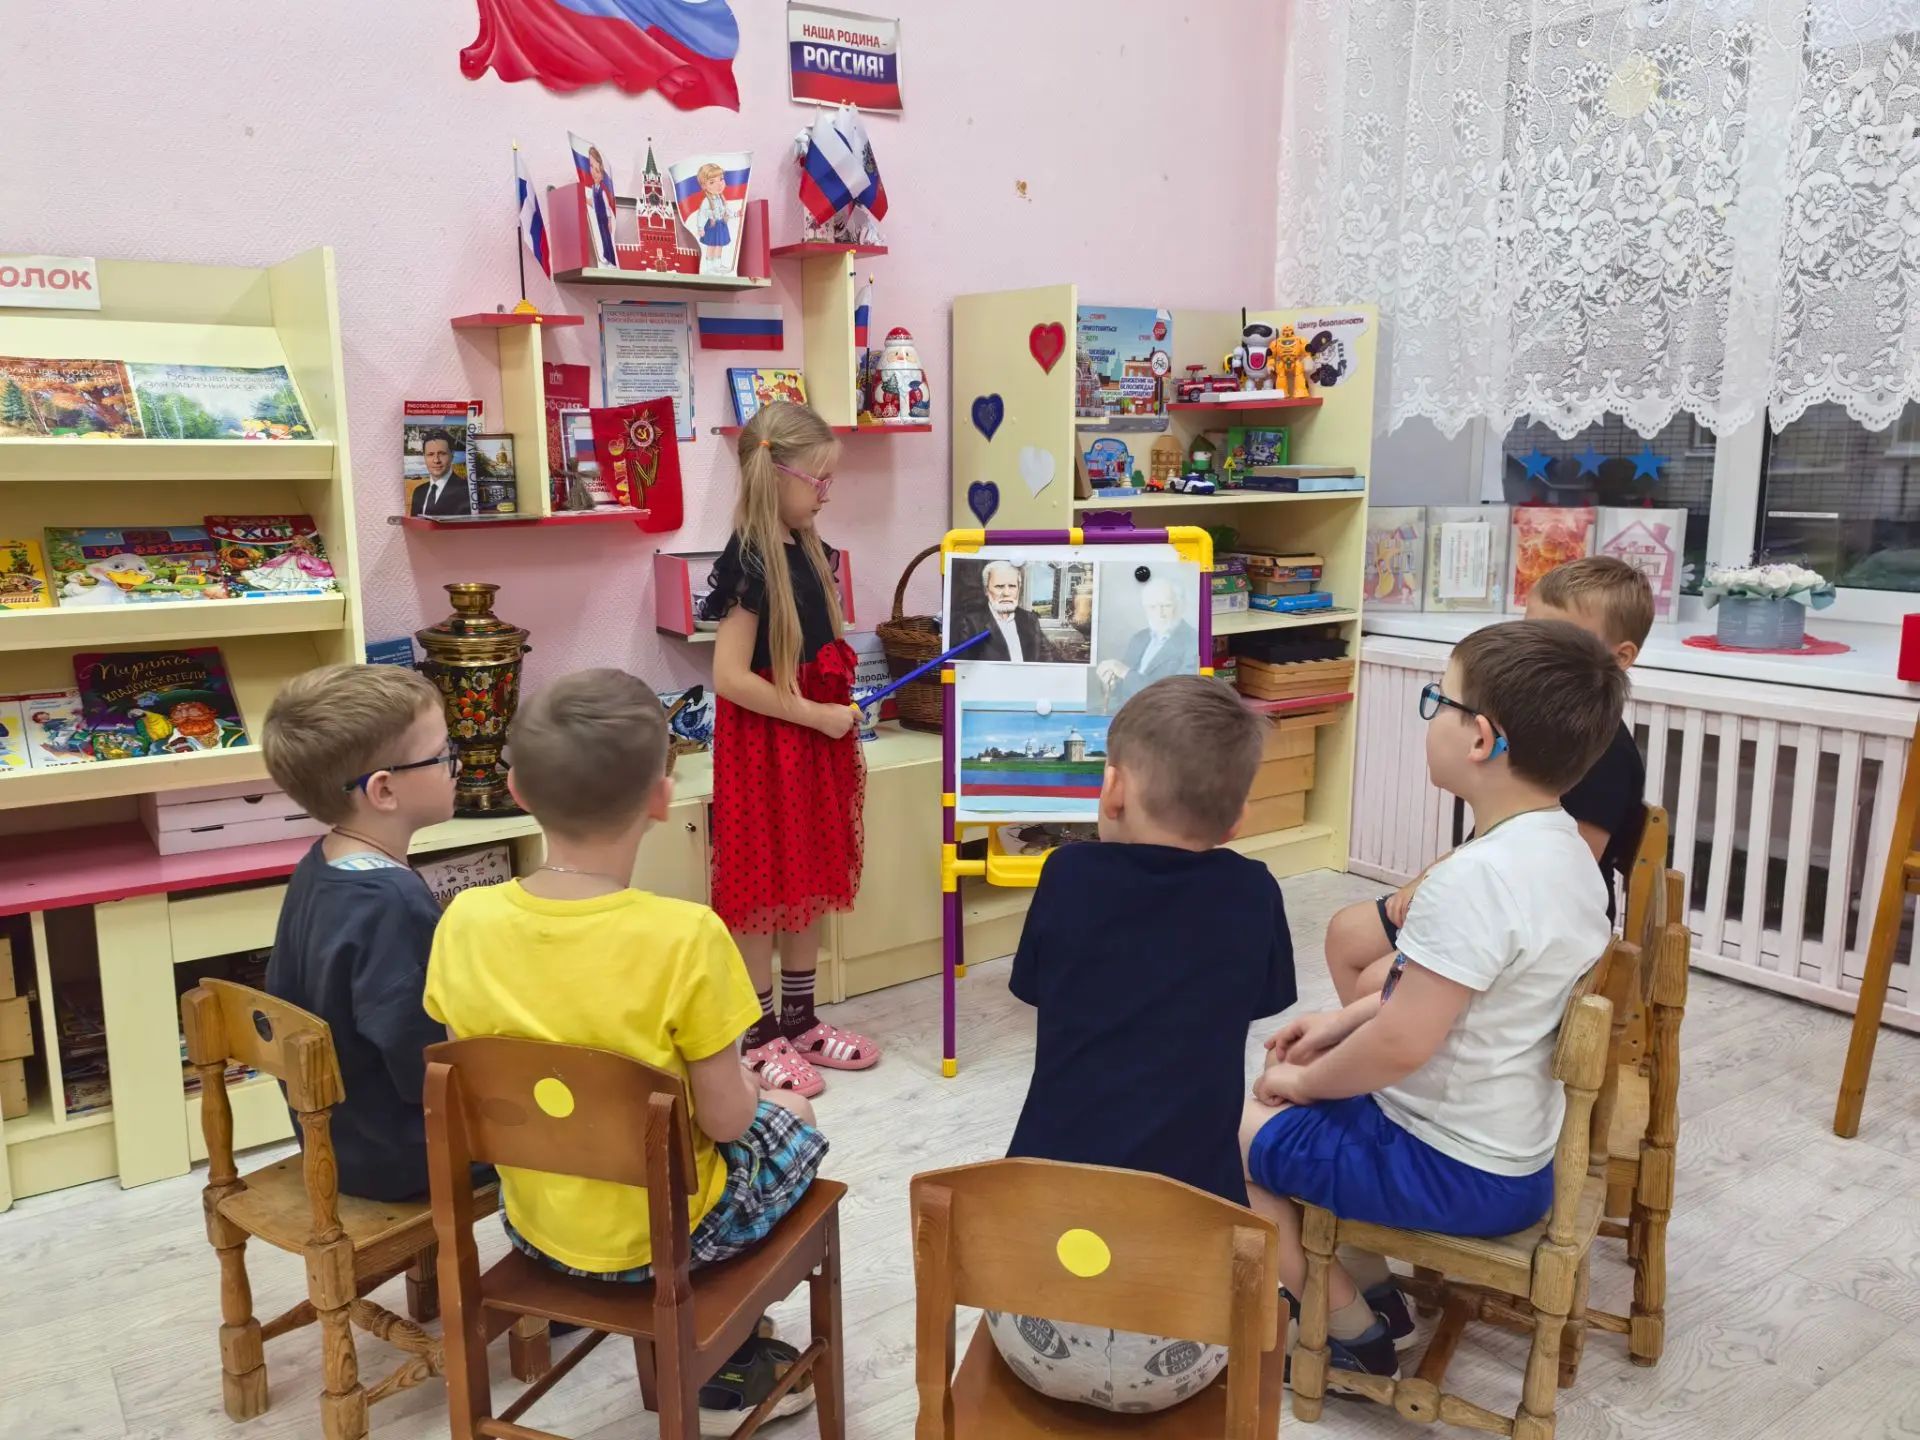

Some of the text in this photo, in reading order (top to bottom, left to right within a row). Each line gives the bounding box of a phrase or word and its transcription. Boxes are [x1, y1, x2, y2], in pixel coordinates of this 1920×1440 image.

[803, 23, 835, 41] НАША
[837, 30, 880, 48] РОДИНА
[803, 45, 885, 79] РОССИЯ!
[1298, 318, 1364, 330] Центр безопасности
[79, 655, 192, 683] Пираты
[102, 671, 207, 702] КЛАДОИСКАТЕЛИ
